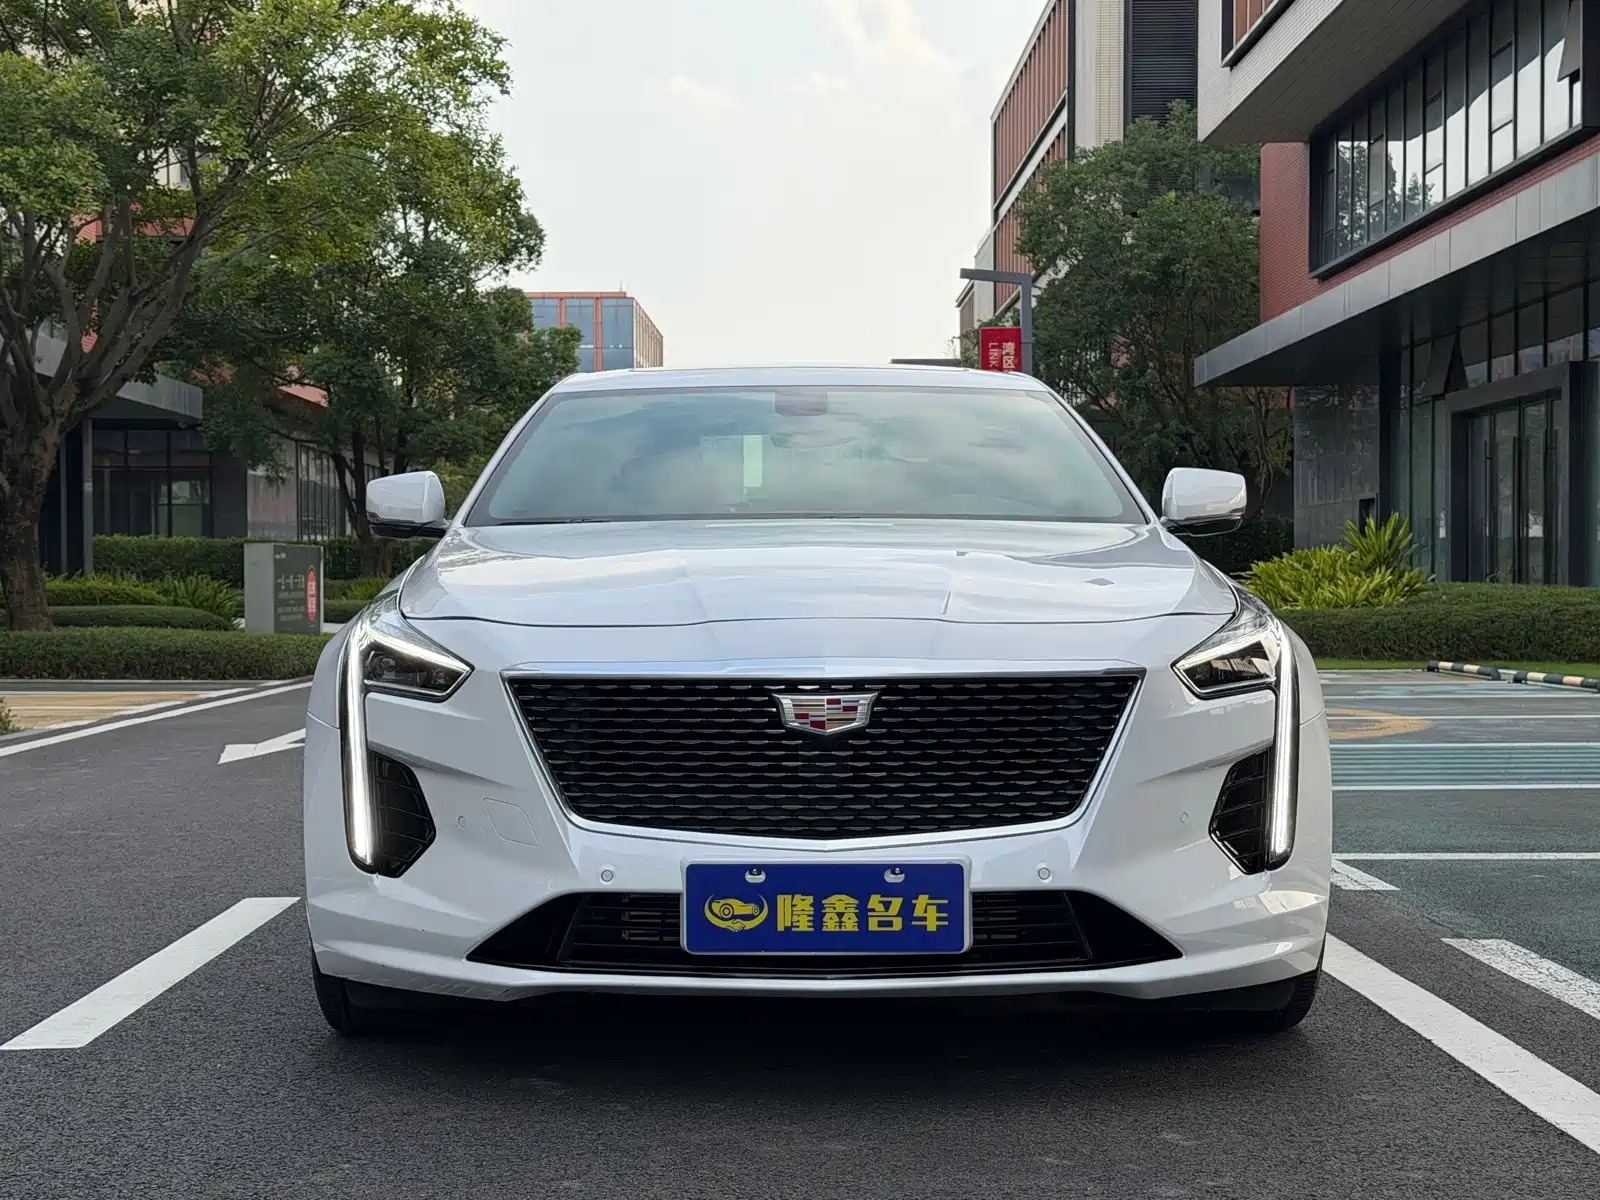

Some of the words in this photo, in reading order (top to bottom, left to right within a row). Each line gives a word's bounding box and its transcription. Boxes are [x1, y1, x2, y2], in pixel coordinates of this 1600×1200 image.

[988, 342, 999, 371] LINK
[1001, 341, 1016, 372] 湾区
[776, 894, 949, 932] 隆鑫名车
